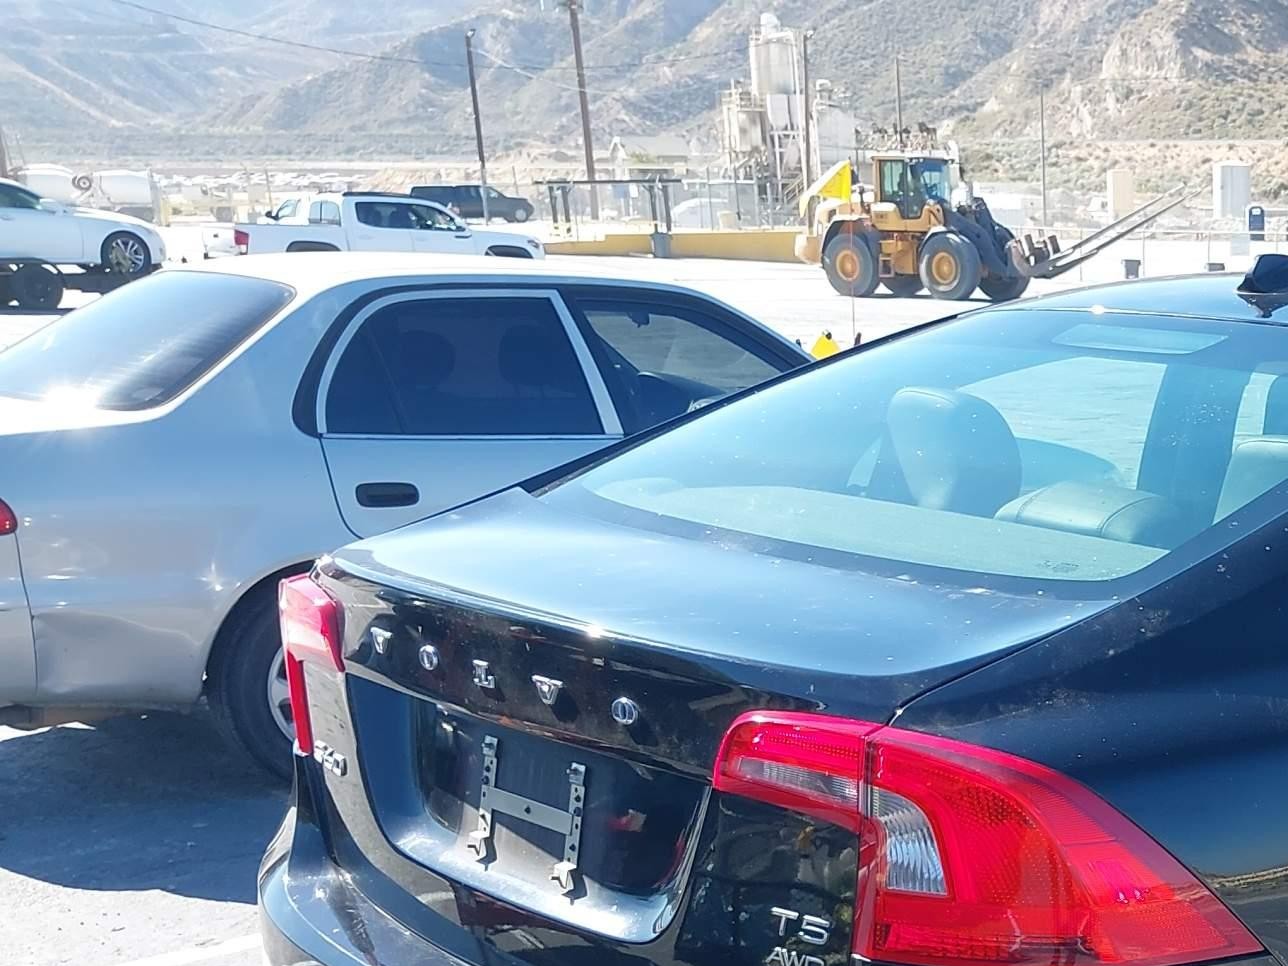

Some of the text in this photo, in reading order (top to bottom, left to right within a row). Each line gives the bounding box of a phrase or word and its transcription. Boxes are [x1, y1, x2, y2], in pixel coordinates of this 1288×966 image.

[370, 625, 641, 726] VOLVO
[314, 740, 347, 777] S60
[770, 907, 832, 946] T5
